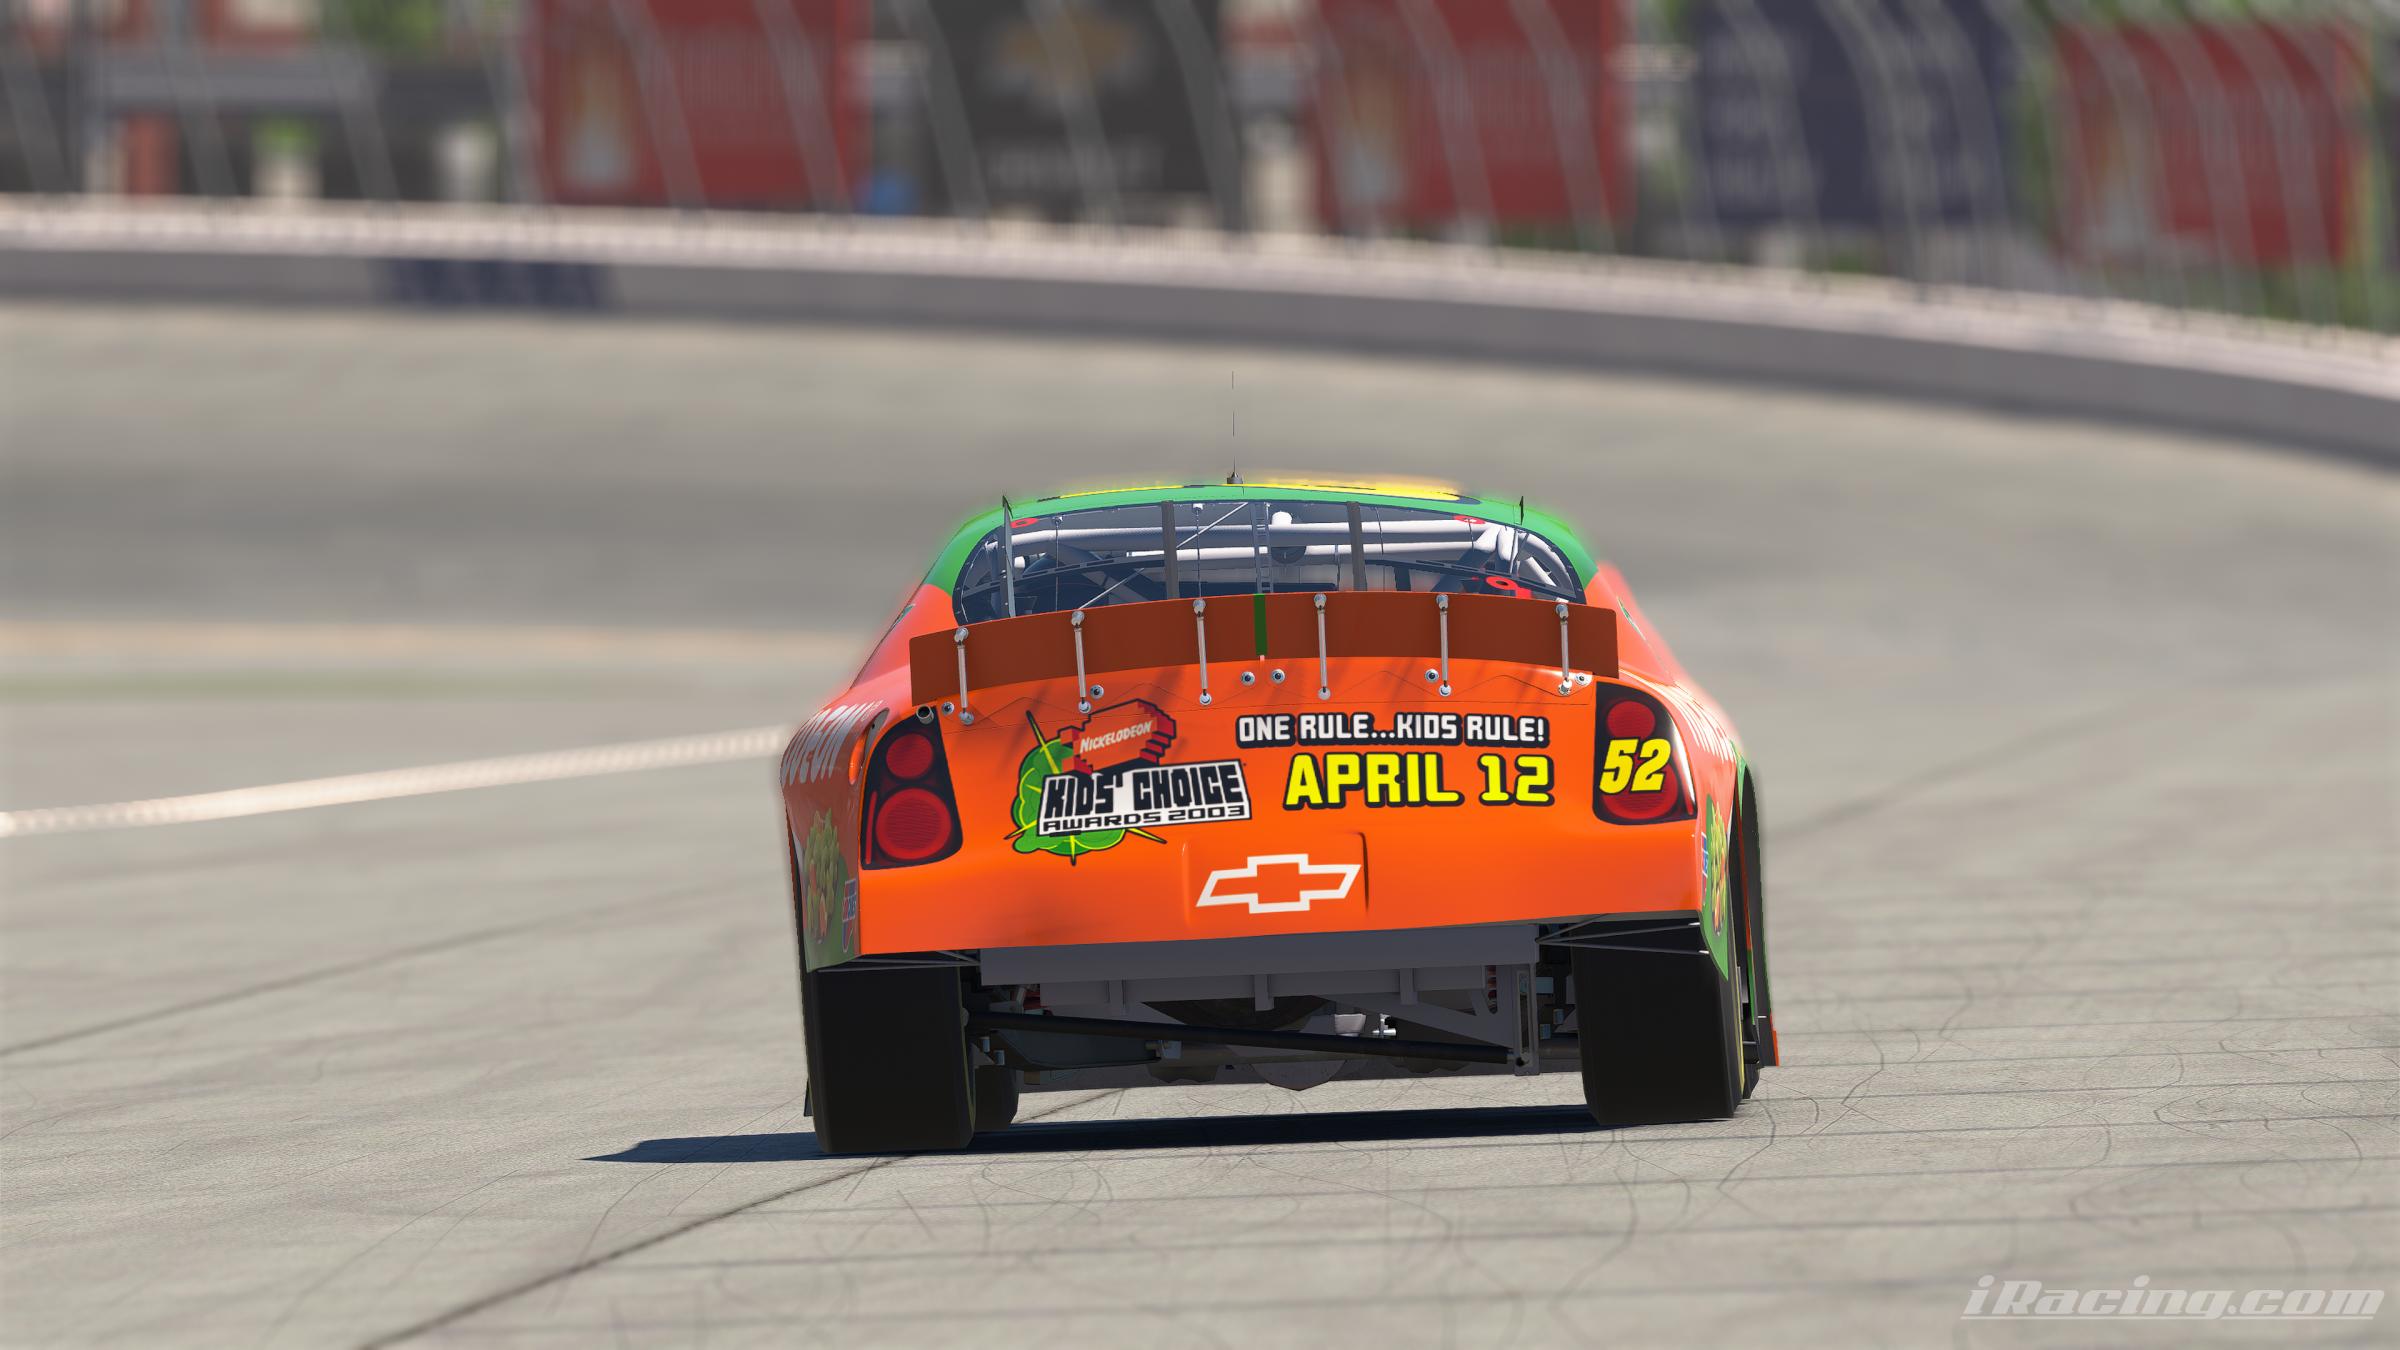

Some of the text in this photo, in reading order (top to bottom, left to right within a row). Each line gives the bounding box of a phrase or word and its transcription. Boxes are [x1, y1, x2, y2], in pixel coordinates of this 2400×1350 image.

[1080, 721, 1153, 753] NICKELODEON
[1238, 713, 1291, 743] ONE
[1466, 714, 1546, 743] RULE!
[1284, 752, 1551, 805] APRIL 12
[1599, 738, 1671, 794] 52
[1044, 764, 1243, 818] KIDS' CHOICE
[1043, 805, 1245, 832] AWARDS 2003
